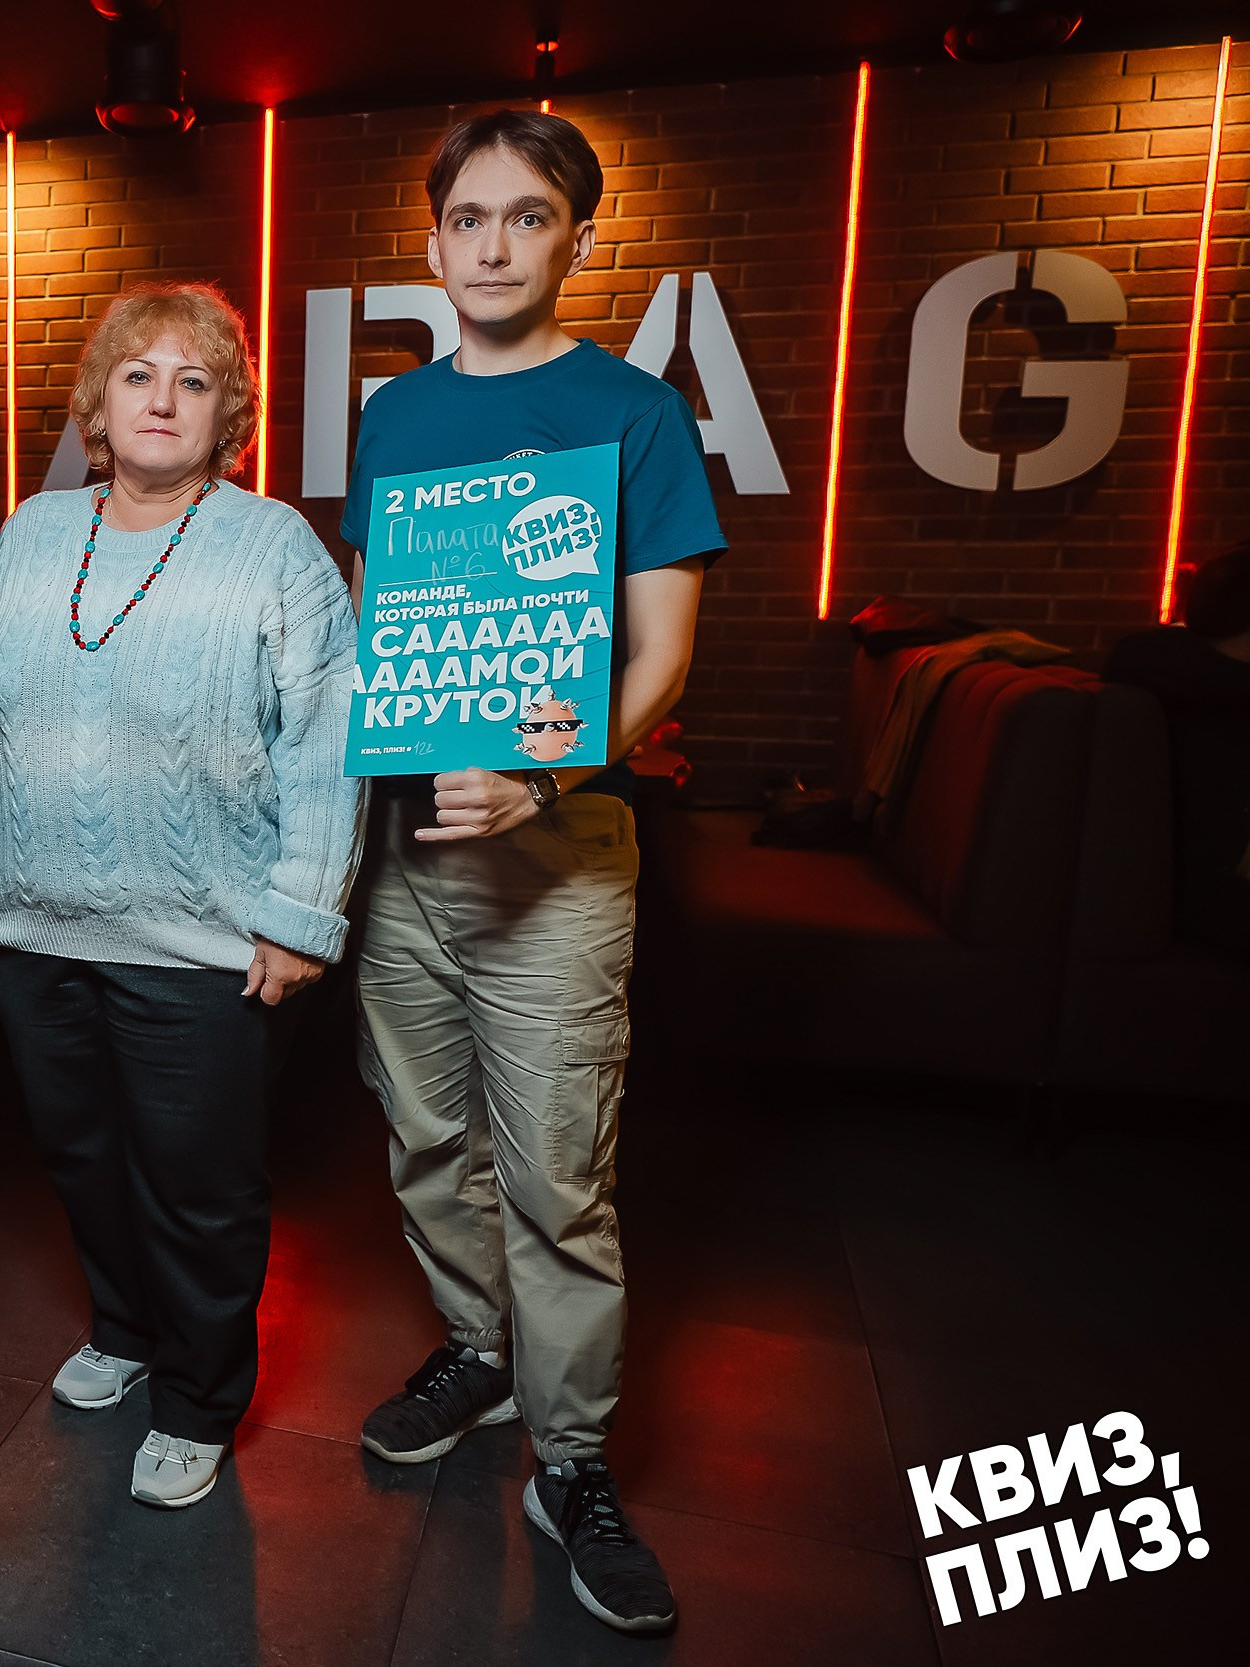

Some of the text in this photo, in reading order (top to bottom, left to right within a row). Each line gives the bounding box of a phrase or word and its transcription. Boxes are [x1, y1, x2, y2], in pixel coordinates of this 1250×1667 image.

[384, 471, 537, 514] 2 МЕСТО
[387, 516, 500, 556] Палата
[505, 502, 599, 550] КВИЗ,
[507, 522, 602, 573] ПЛИЗ!
[374, 588, 590, 623] КОТОРАЯ БЫЛА ПОЧТИ
[375, 584, 472, 606] КОМАНДЕ,
[361, 747, 382, 755] КВИЗ,
[383, 746, 405, 754] ПЛИЗ!
